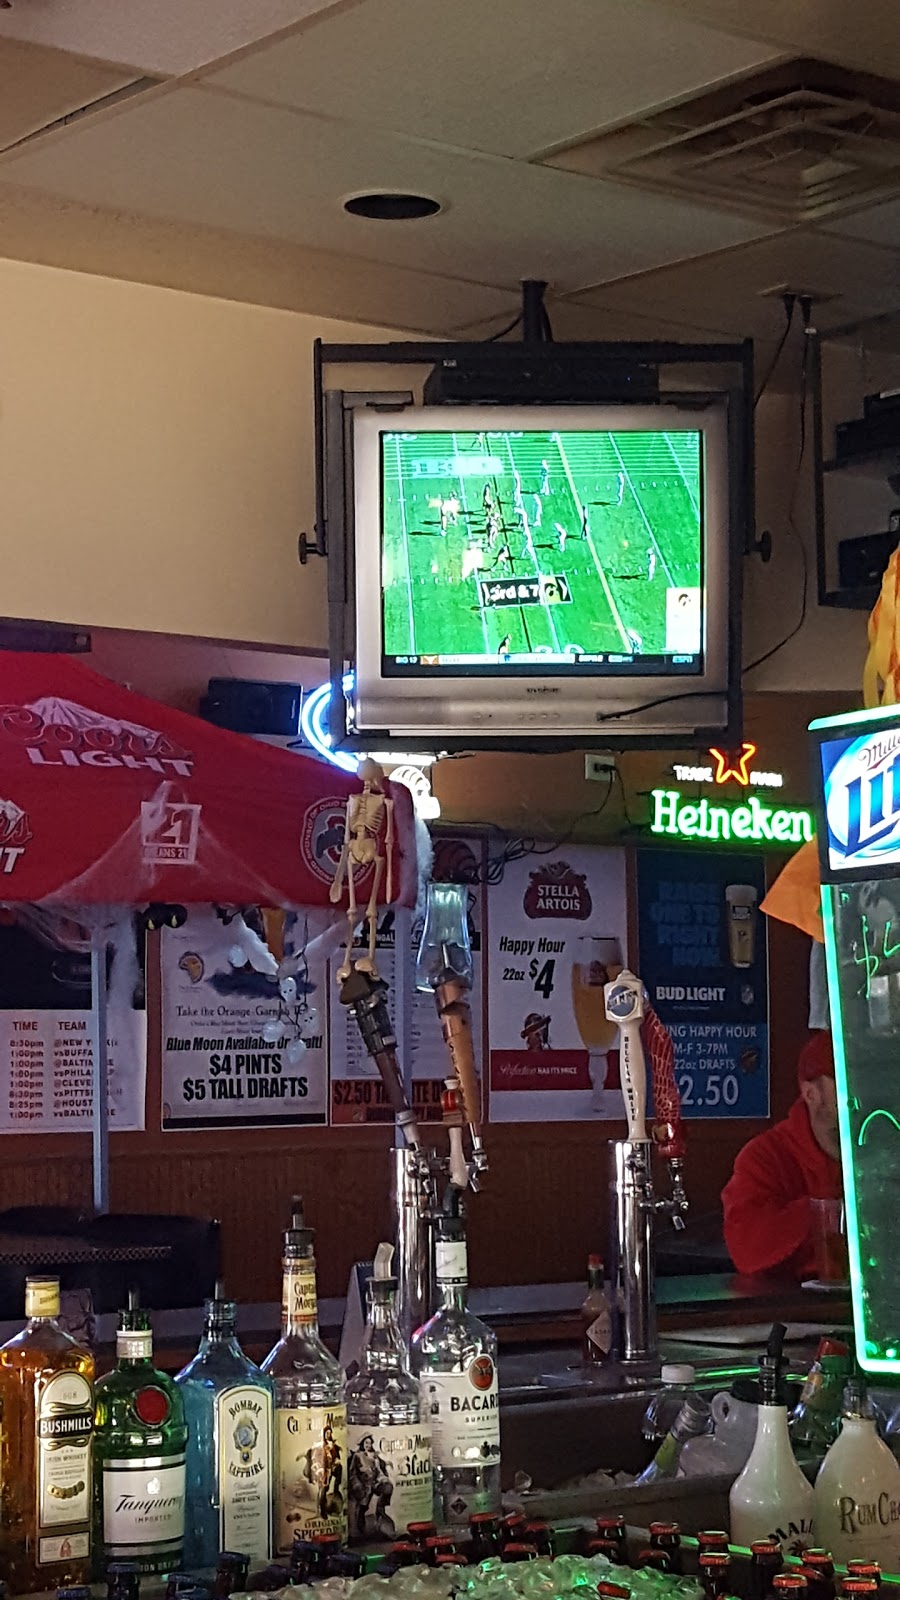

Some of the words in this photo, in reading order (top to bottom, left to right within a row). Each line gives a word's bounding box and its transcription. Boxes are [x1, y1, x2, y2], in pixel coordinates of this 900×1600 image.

[490, 584, 517, 602] 3rd
[518, 584, 530, 598] &
[530, 584, 539, 597] 7
[857, 734, 900, 771] Mille
[26, 747, 194, 777] LIGHT
[845, 752, 900, 858] Lit
[651, 789, 814, 843] Heineken
[538, 885, 580, 897] STELLA
[536, 898, 581, 911] ARTOIS
[499, 936, 535, 955] Happy
[537, 937, 566, 953] Hour
[502, 967, 526, 981] 22oz
[528, 957, 556, 999] $4
[656, 986, 685, 1000] BUD
[687, 986, 726, 1001] LIGHT
[176, 1005, 199, 1017] Take
[201, 1005, 215, 1017] the
[13, 1021, 38, 1031] TIME
[58, 1021, 87, 1031] TEAM
[690, 1025, 725, 1038] HAPPY
[726, 1026, 757, 1038] HOUR
[9, 1040, 44, 1048] 8:30pm
[167, 1037, 191, 1051] Blue
[192, 1037, 224, 1051] Moon
[673, 1043, 693, 1054] M-F
[696, 1043, 728, 1055] 3-7PM
[11, 1050, 44, 1059] 1:00pm
[624, 1036, 632, 1083] BELGIAN
[10, 1060, 44, 1069] 1:00pm
[209, 1053, 232, 1077] $4
[235, 1053, 282, 1075] PINTS
[537, 1066, 550, 1075] HAS
[550, 1066, 560, 1075] ITS
[560, 1066, 578, 1075] PRICE
[674, 1059, 696, 1070] 22oz
[699, 1059, 736, 1071] DRAFTS
[10, 1070, 44, 1079] 1:00pm
[10, 1080, 44, 1089] 1:00pm
[183, 1077, 206, 1102] $5
[209, 1078, 244, 1100] TALL
[247, 1077, 308, 1098] DRAFTS
[9, 1091, 43, 1099] 8:30pm
[333, 1080, 372, 1105] $2.50
[626, 1087, 636, 1122] WHITE
[228, 1400, 263, 1419] BOMBAY
[40, 1416, 92, 1435] BUSHMILLS
[135, 1513, 172, 1524] IMPORTED
